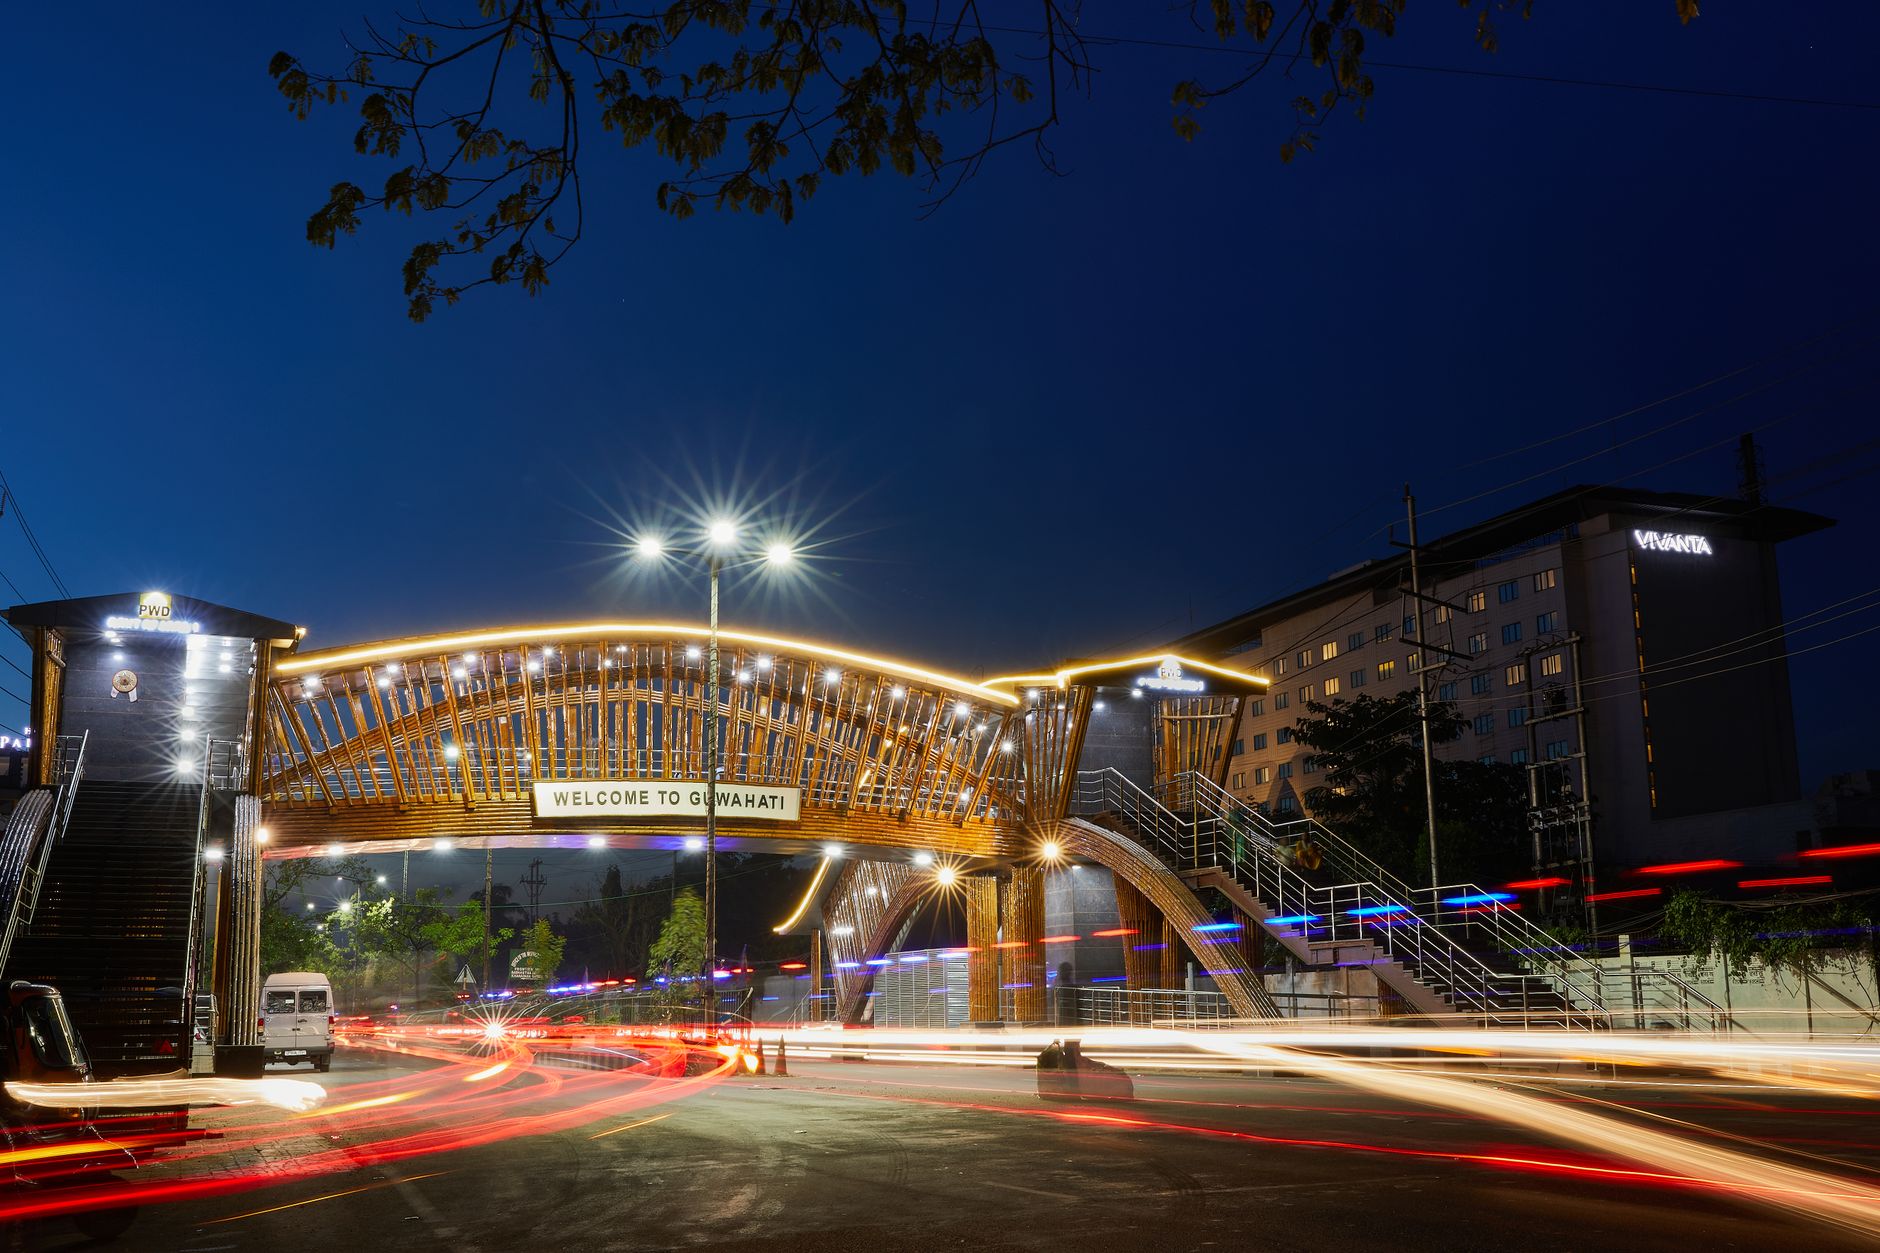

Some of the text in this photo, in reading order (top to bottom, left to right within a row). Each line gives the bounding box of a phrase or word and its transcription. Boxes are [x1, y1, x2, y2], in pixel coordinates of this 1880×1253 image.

[1634, 529, 1712, 555] VIVANTA
[139, 604, 170, 617] PWD
[553, 790, 649, 806] WELCOME
[658, 790, 680, 806] TO
